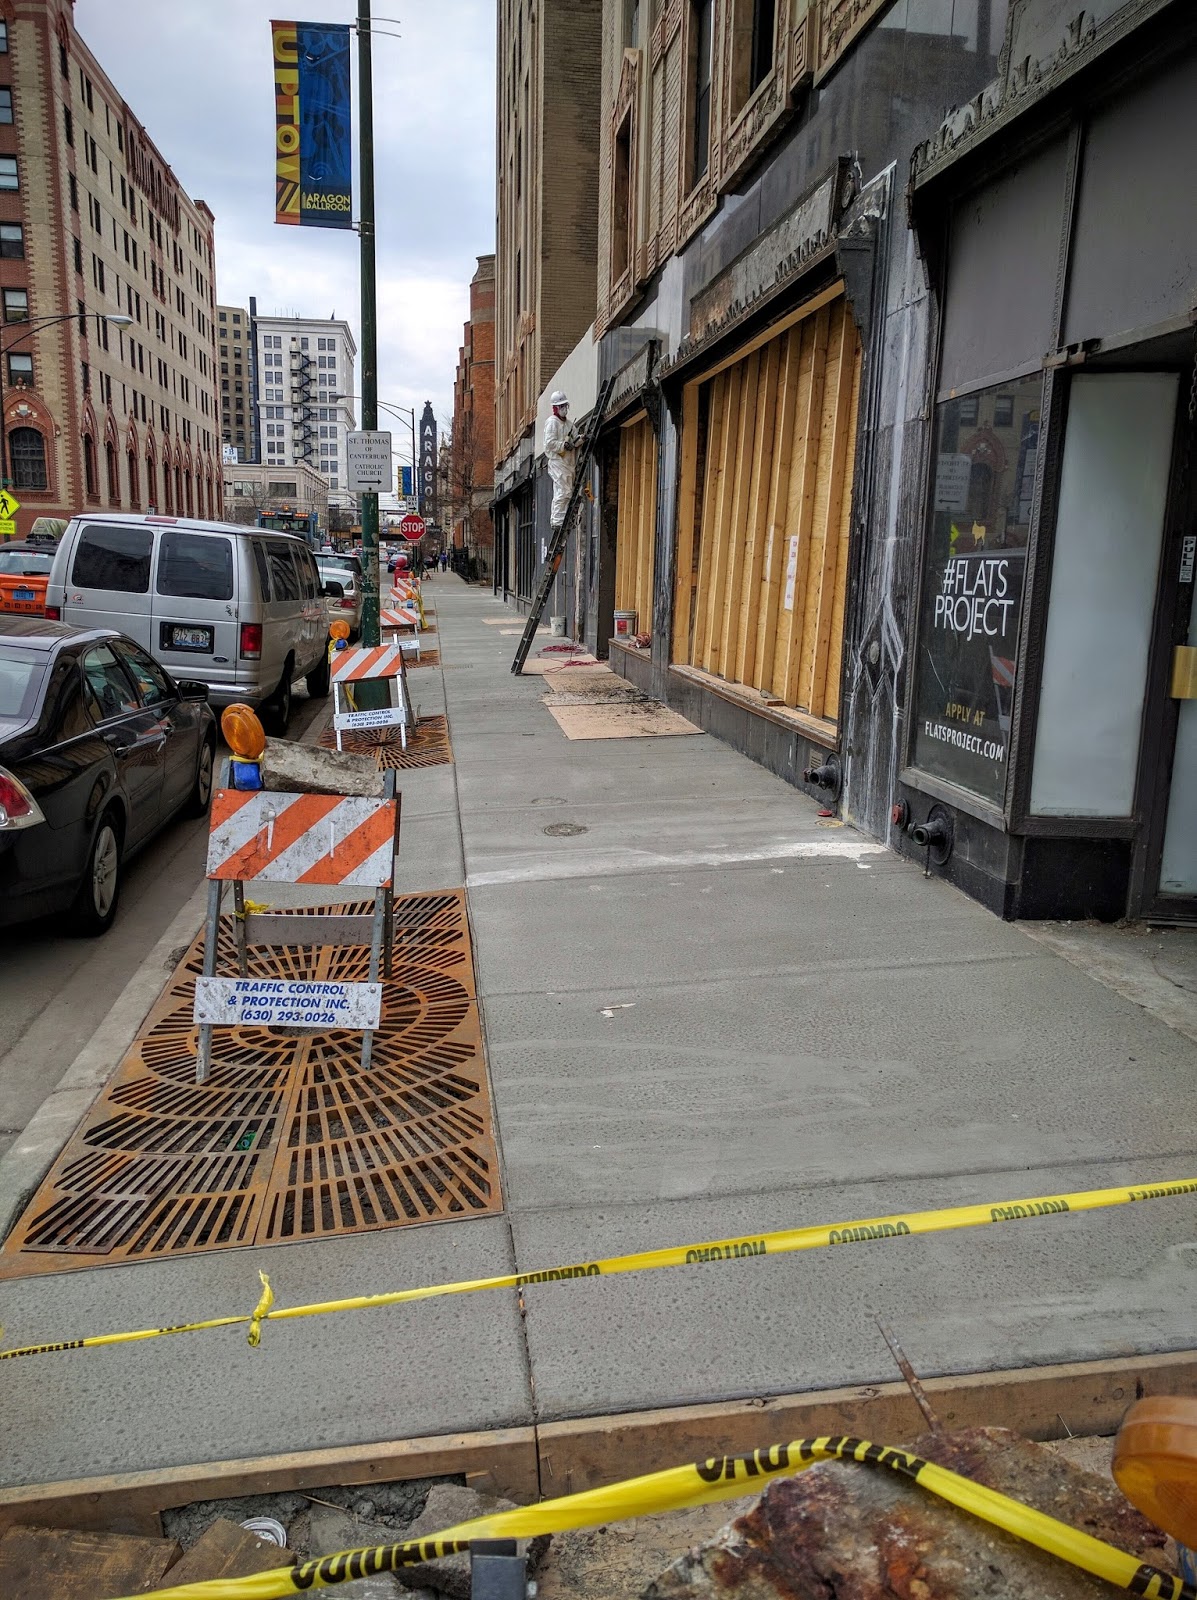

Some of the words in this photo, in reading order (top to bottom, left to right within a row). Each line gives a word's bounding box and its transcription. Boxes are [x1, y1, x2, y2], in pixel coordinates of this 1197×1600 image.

[306, 201, 350, 212] BALLROOM
[307, 193, 350, 204] ARAGON
[424, 424, 433, 511] ARAGON
[401, 522, 424, 533] STOP
[1182, 540, 1195, 567] PULL
[943, 559, 1009, 598] #FLATS
[934, 595, 1014, 641] PROJECT
[945, 702, 971, 723] APPLY
[973, 709, 986, 727] AT
[924, 720, 1005, 762] FLATSPROJECT.COM
[235, 981, 285, 993] TRAFFIC
[288, 983, 345, 995] CONTROL
[227, 995, 237, 1006] &
[241, 996, 323, 1008] PROTECTION
[325, 999, 350, 1010] INC.
[240, 1009, 273, 1022] (630)
[277, 1011, 336, 1023] 293-0026
